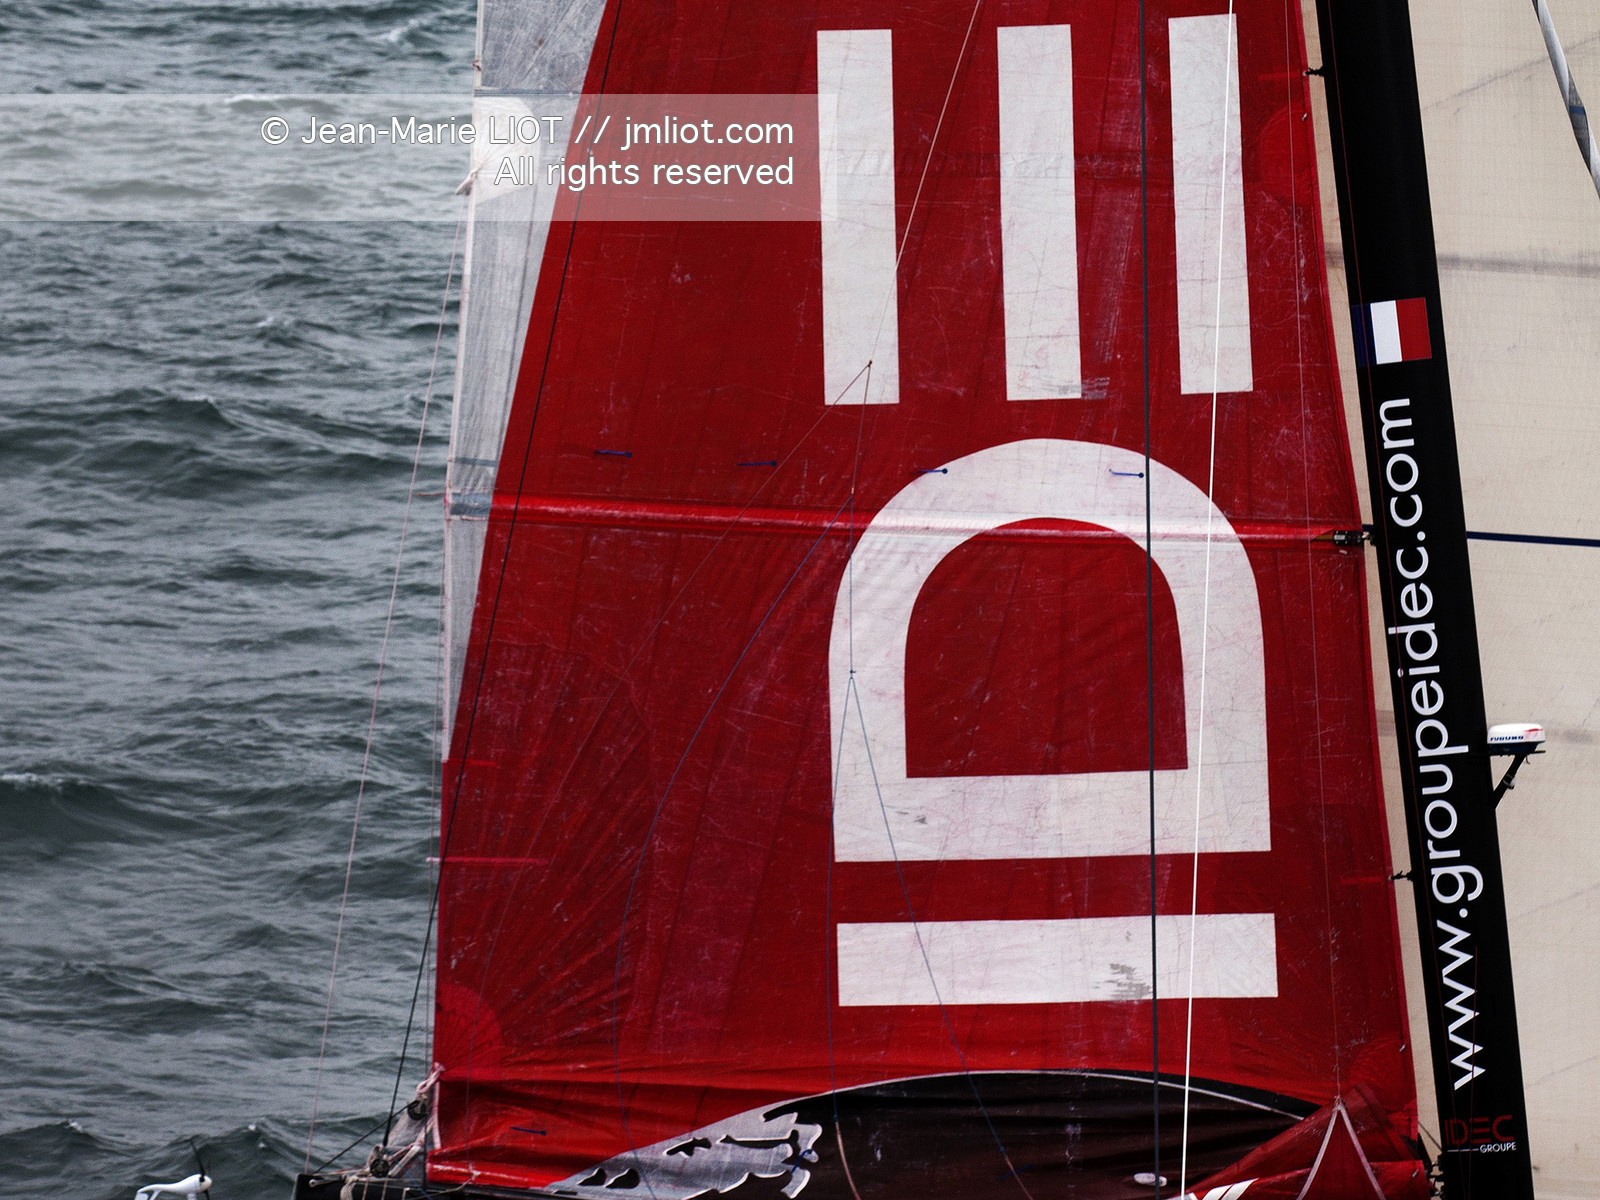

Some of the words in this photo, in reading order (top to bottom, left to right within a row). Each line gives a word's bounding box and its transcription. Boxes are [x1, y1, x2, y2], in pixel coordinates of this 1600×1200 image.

[1379, 397, 1485, 1092] www.groupeidec.com
[1444, 1114, 1515, 1145] IDEC
[1479, 1141, 1517, 1154] GROUPE
